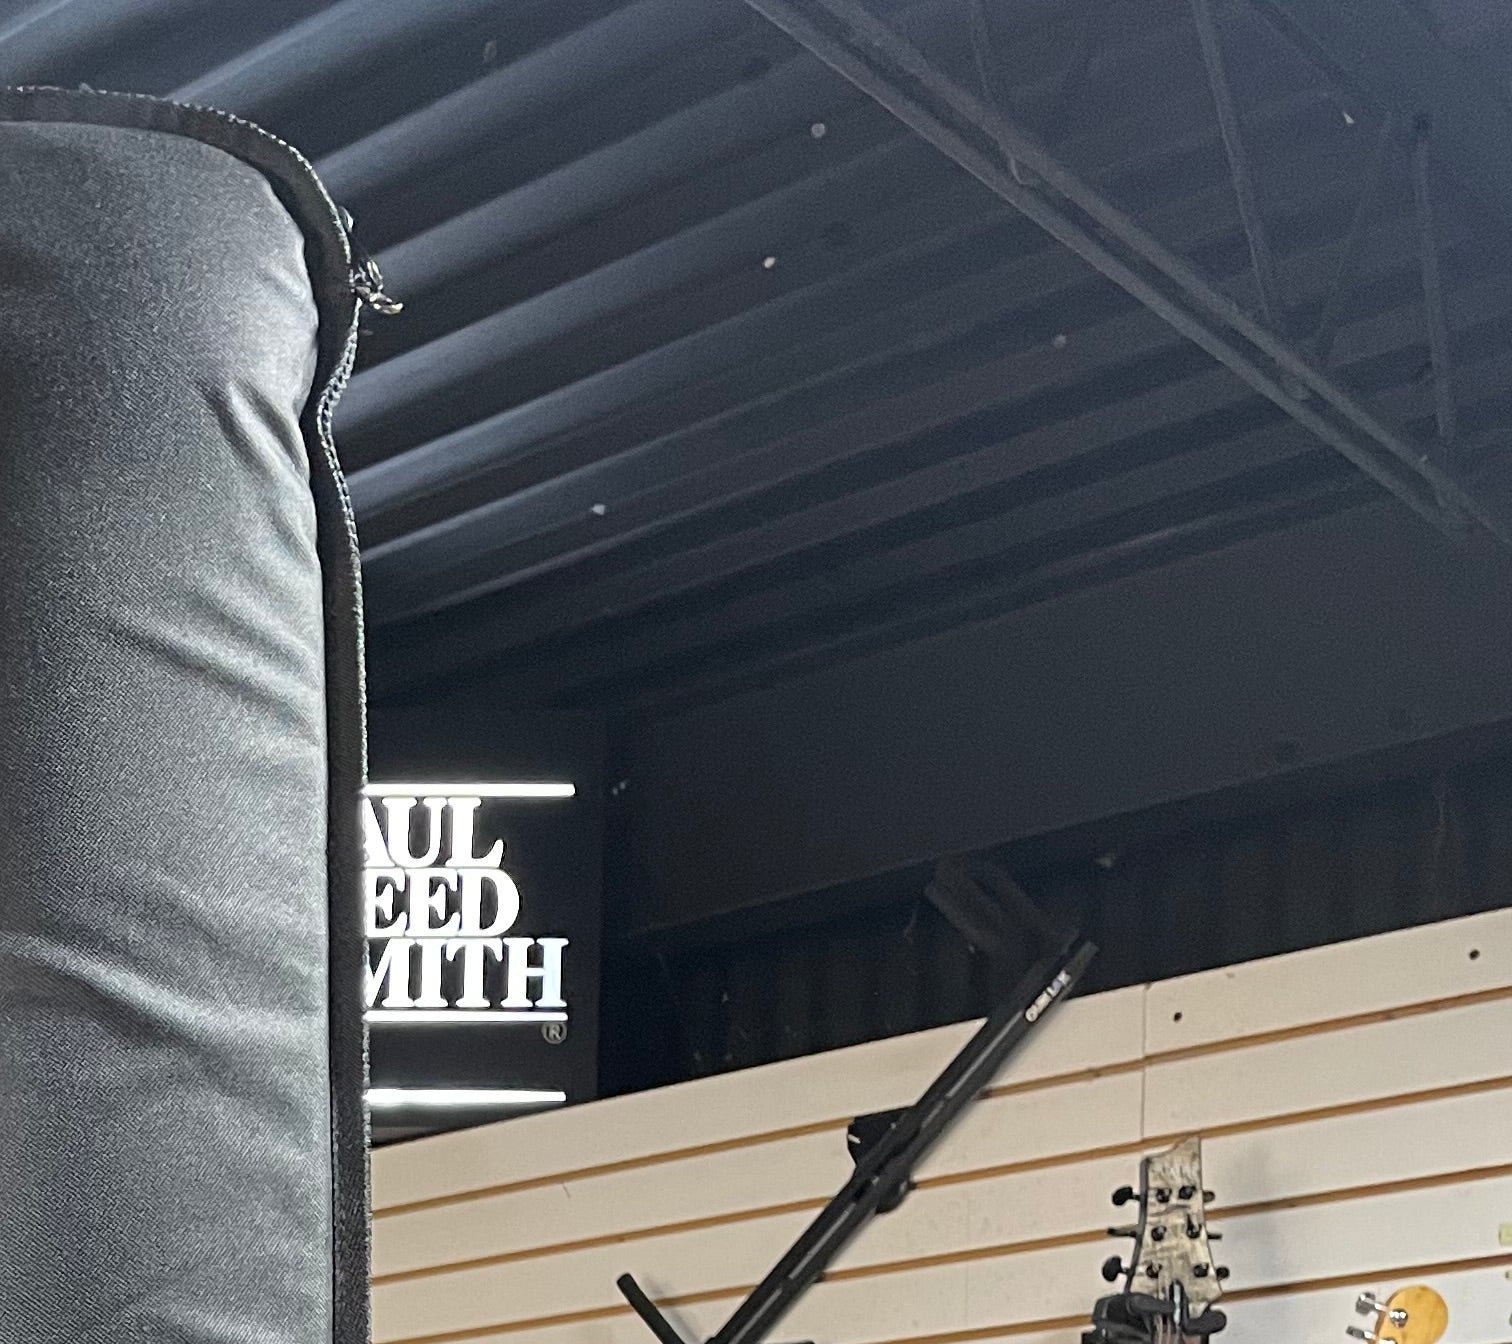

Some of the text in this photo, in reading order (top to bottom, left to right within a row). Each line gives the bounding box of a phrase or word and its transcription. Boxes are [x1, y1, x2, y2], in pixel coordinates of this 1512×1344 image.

[364, 797, 504, 868] AUL
[366, 868, 520, 936] EED
[366, 937, 570, 1008] MITH
